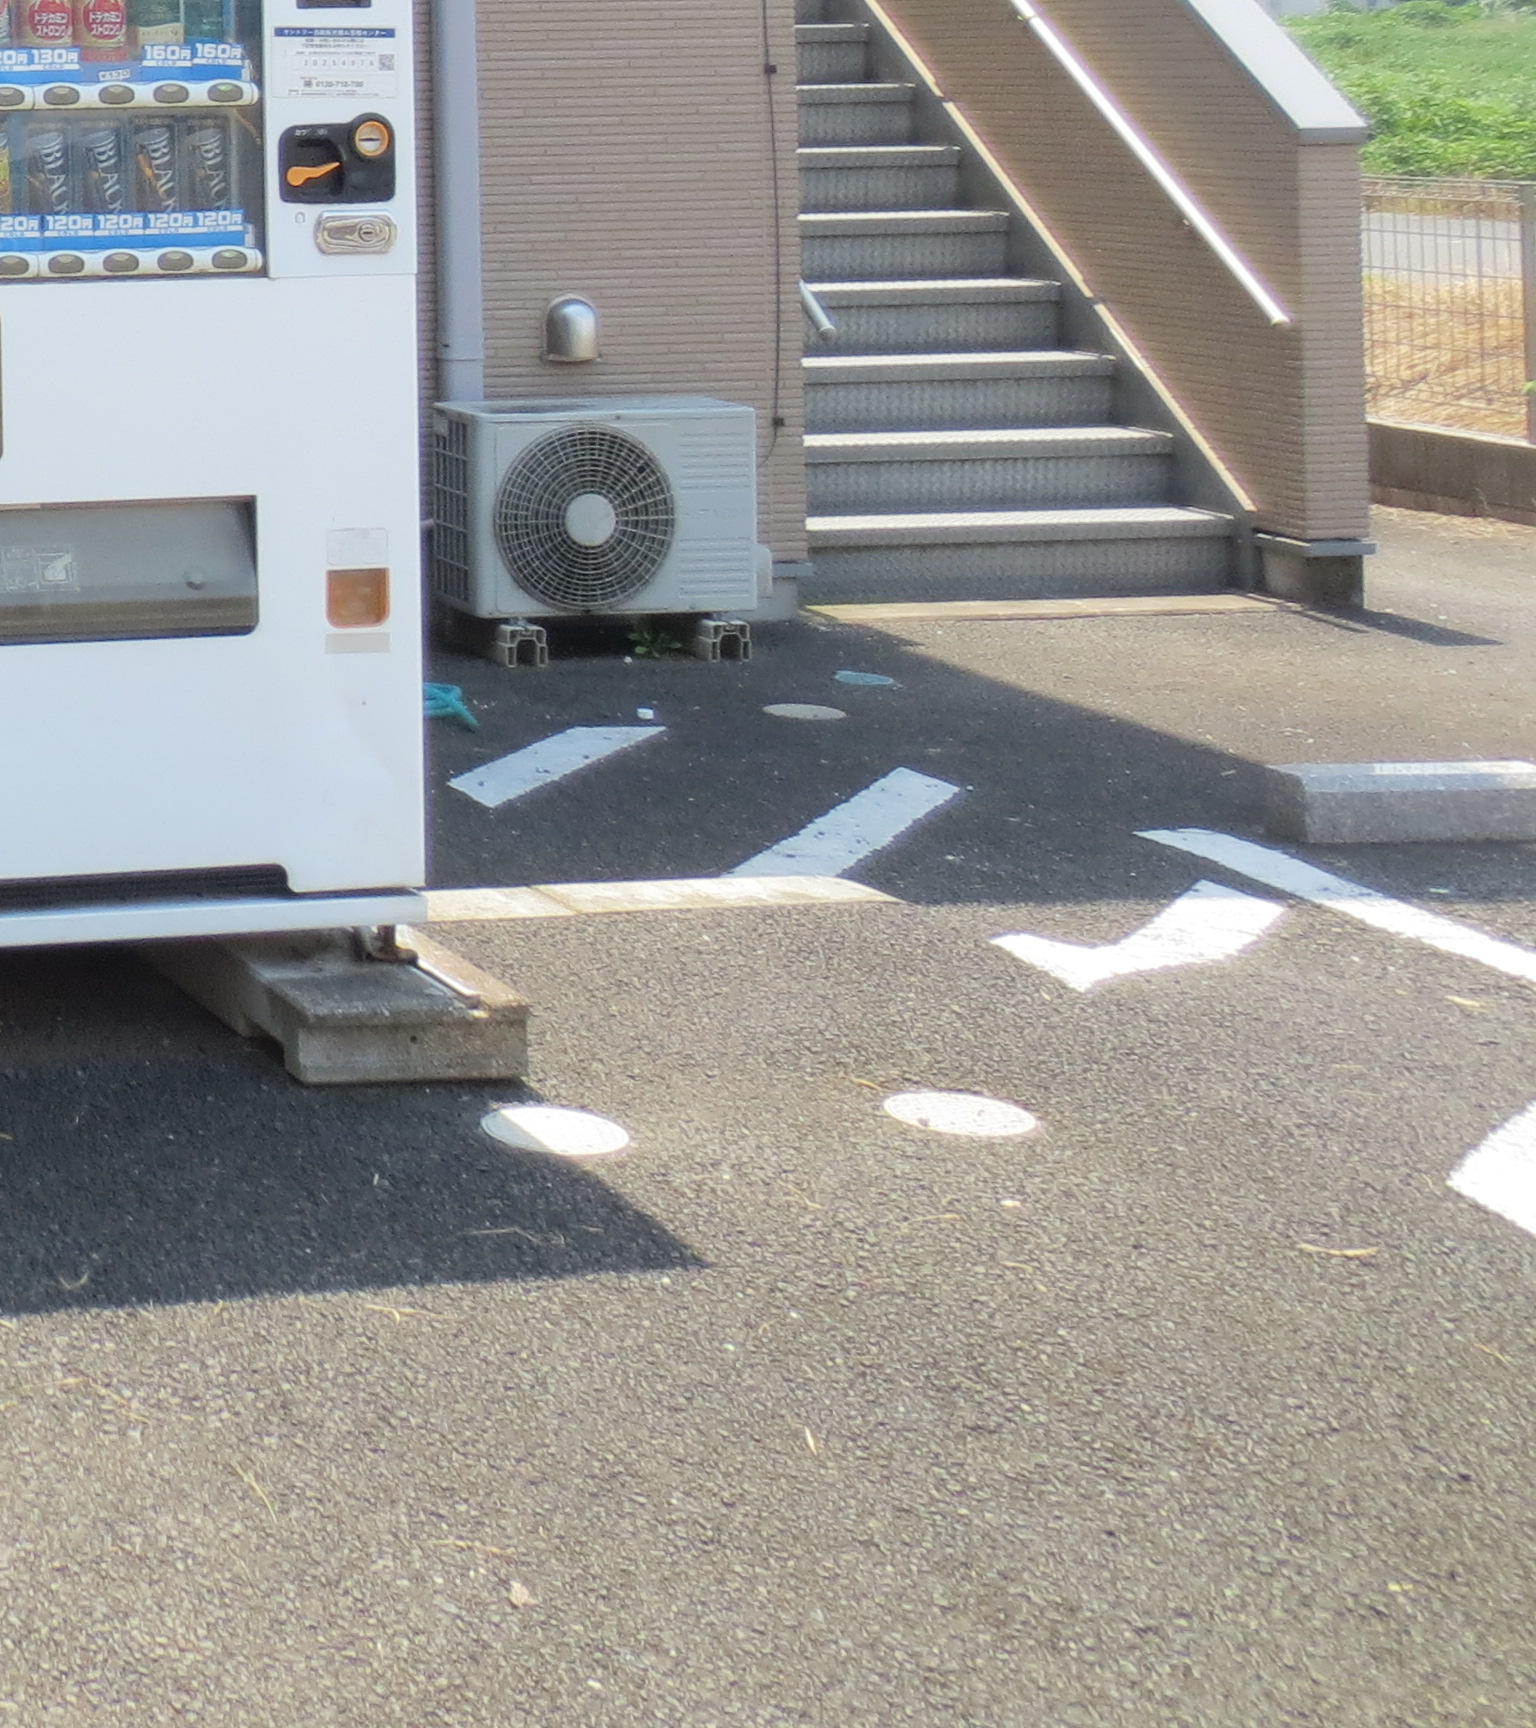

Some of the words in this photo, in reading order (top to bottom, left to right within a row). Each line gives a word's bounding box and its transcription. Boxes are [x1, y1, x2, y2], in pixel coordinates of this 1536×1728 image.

[31, 49, 79, 64] 130円
[46, 215, 92, 230] 120円
[97, 214, 143, 229] 120円
[148, 213, 194, 228] 120円
[196, 211, 243, 226] 120円
